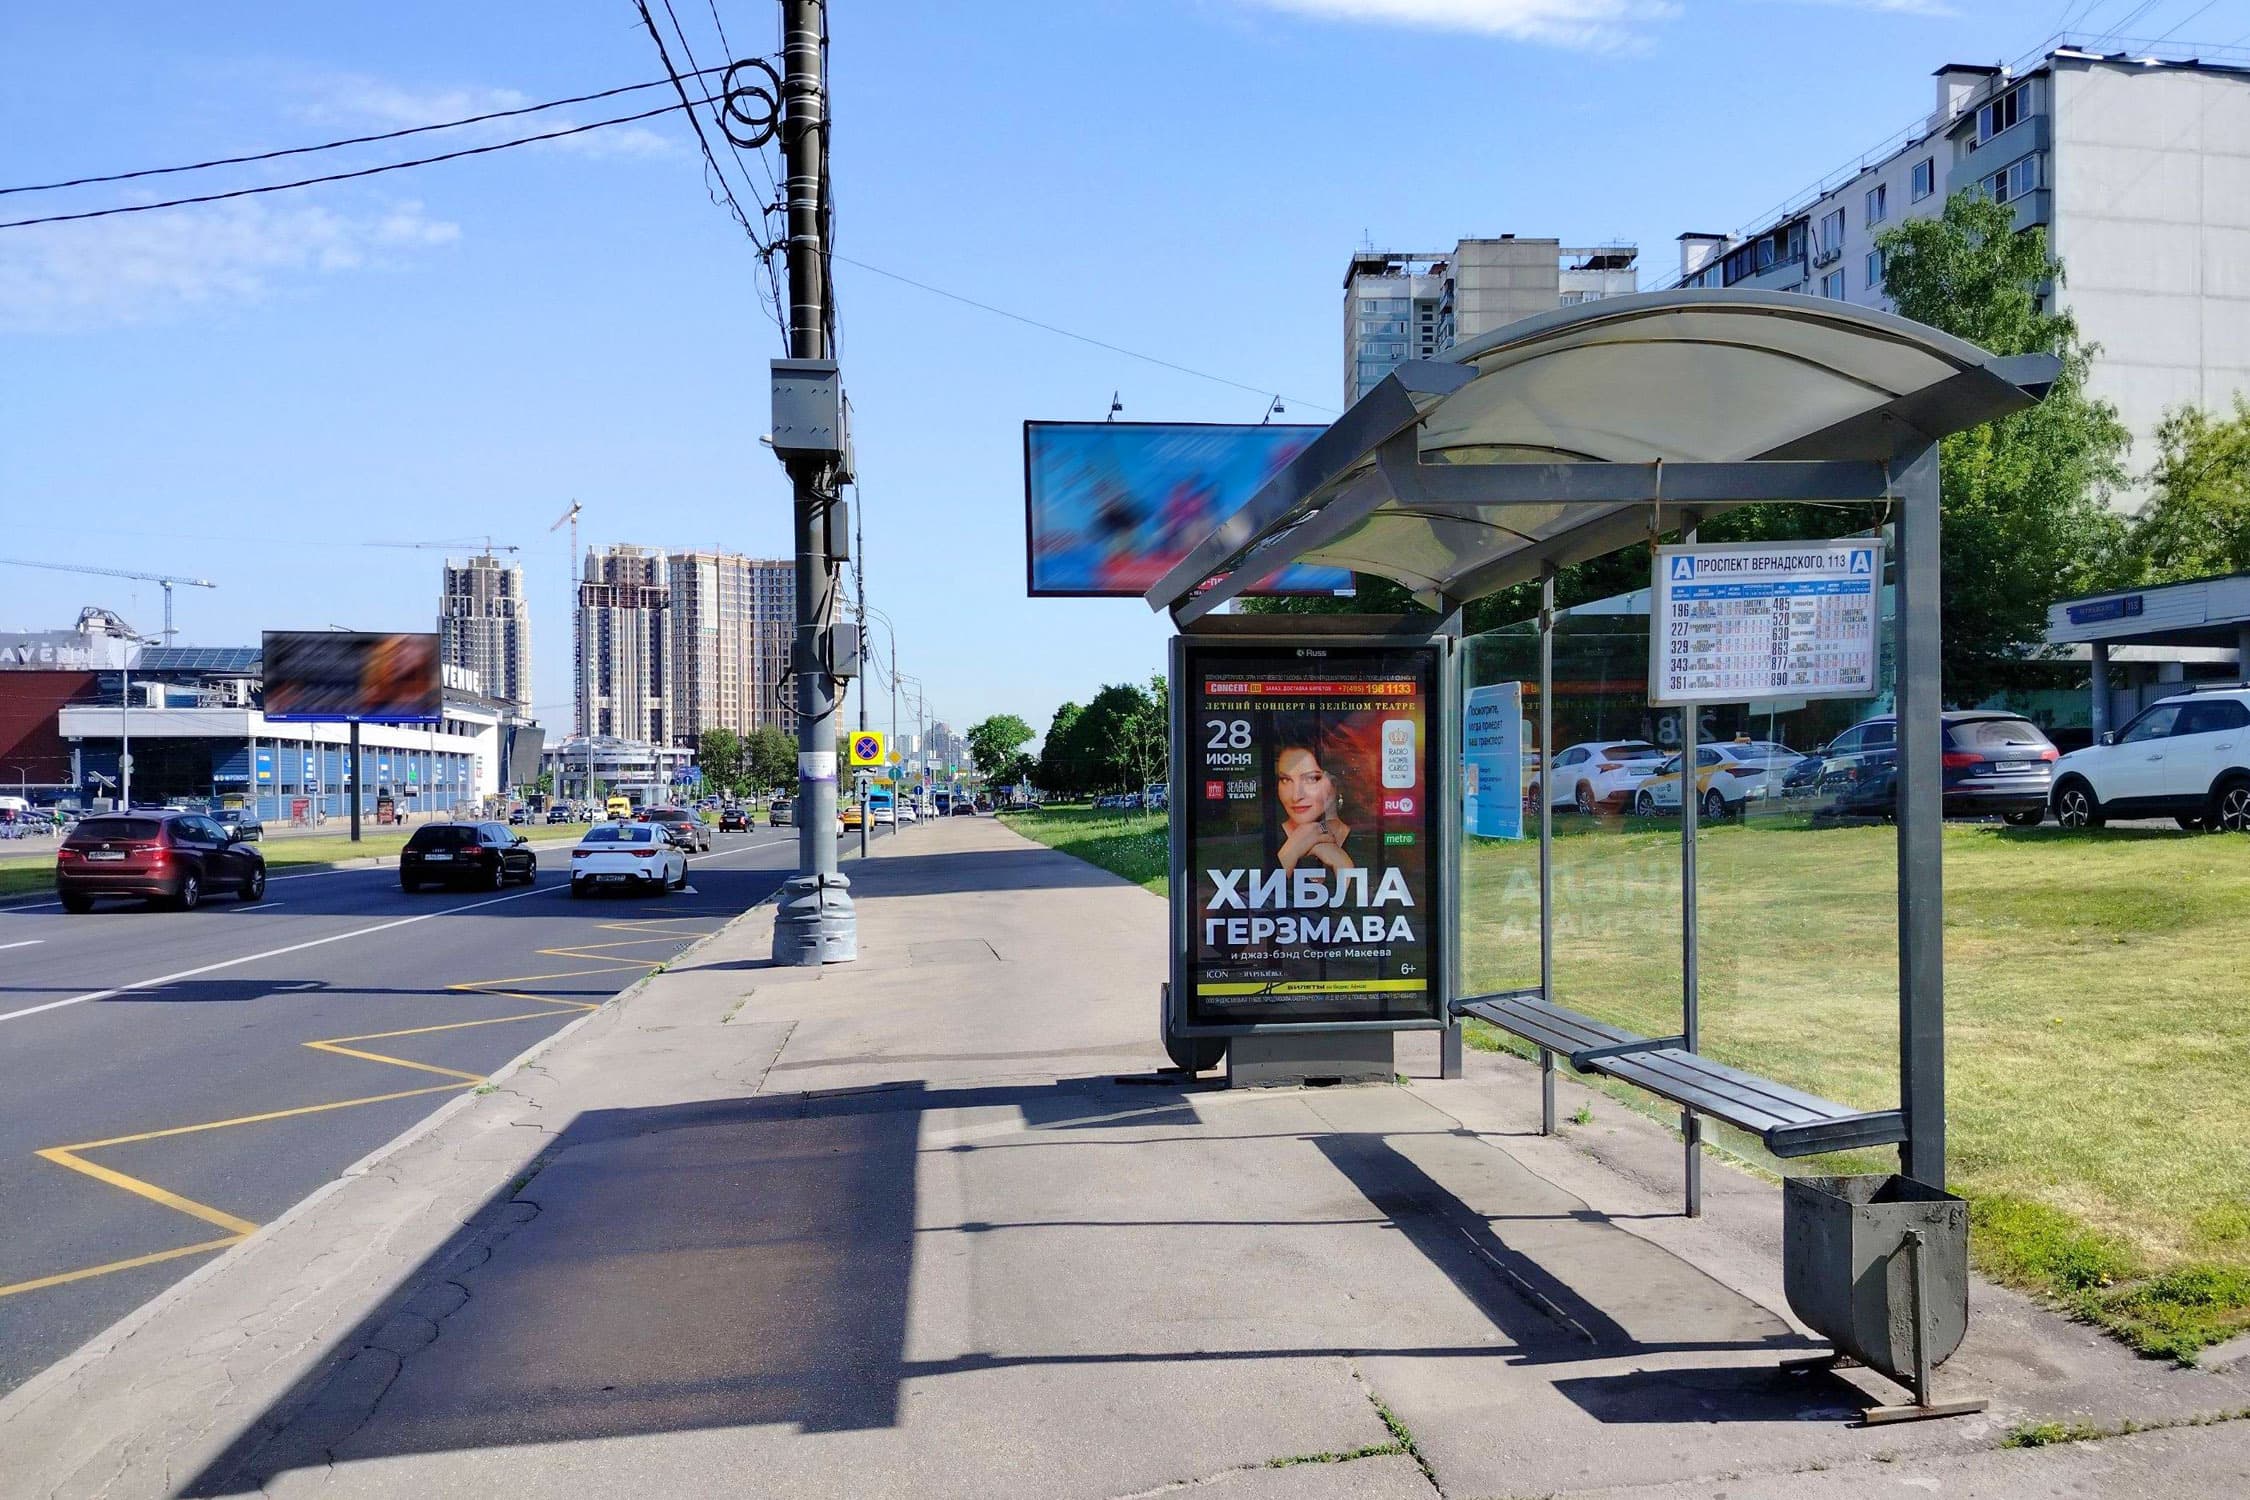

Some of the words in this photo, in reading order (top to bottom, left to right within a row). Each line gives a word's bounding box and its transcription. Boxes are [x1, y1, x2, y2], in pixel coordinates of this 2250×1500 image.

[1696, 558, 1749, 573] ПРОСПЕКТ
[1828, 554, 1846, 568] 113
[1672, 603, 1689, 618] 196
[1772, 597, 1790, 611] 485
[1772, 612, 1790, 626] 520
[1671, 622, 1689, 636] 227
[1772, 627, 1790, 641] 630
[1306, 648, 1327, 657] Russ
[1671, 640, 1689, 654] 329
[1771, 642, 1789, 656] 863
[1670, 658, 1689, 673] 343
[1771, 656, 1788, 671] 877
[1670, 676, 1687, 690] 361
[1770, 672, 1788, 686] 890
[1365, 683, 1384, 694] 198
[1386, 683, 1412, 694] 1133
[1205, 701, 1251, 711] ЛЕТНИЙ
[1254, 701, 1305, 712] КОНЦЕРТ
[1309, 702, 1316, 711] В
[1319, 700, 1372, 711] ЗЕЛЁНОМ
[1375, 701, 1416, 711] ТЕАТРЕ
[1205, 719, 1252, 750] 28
[1205, 752, 1252, 765] ИЮНЯ
[1228, 792, 1257, 800] ТЕАТР
[1384, 800, 1399, 810] RU
[1386, 834, 1413, 844] metro
[1205, 866, 1415, 911] ХИБЛА
[1205, 914, 1415, 946] ГЕРЗМАВА
[1231, 952, 1238, 960] и
[1240, 949, 1300, 961] джаз-бэнд
[1302, 949, 1342, 961] Сергея
[1344, 947, 1392, 959] Макеева
[1206, 970, 1229, 979] ICON
[1400, 963, 1417, 975] 6+
